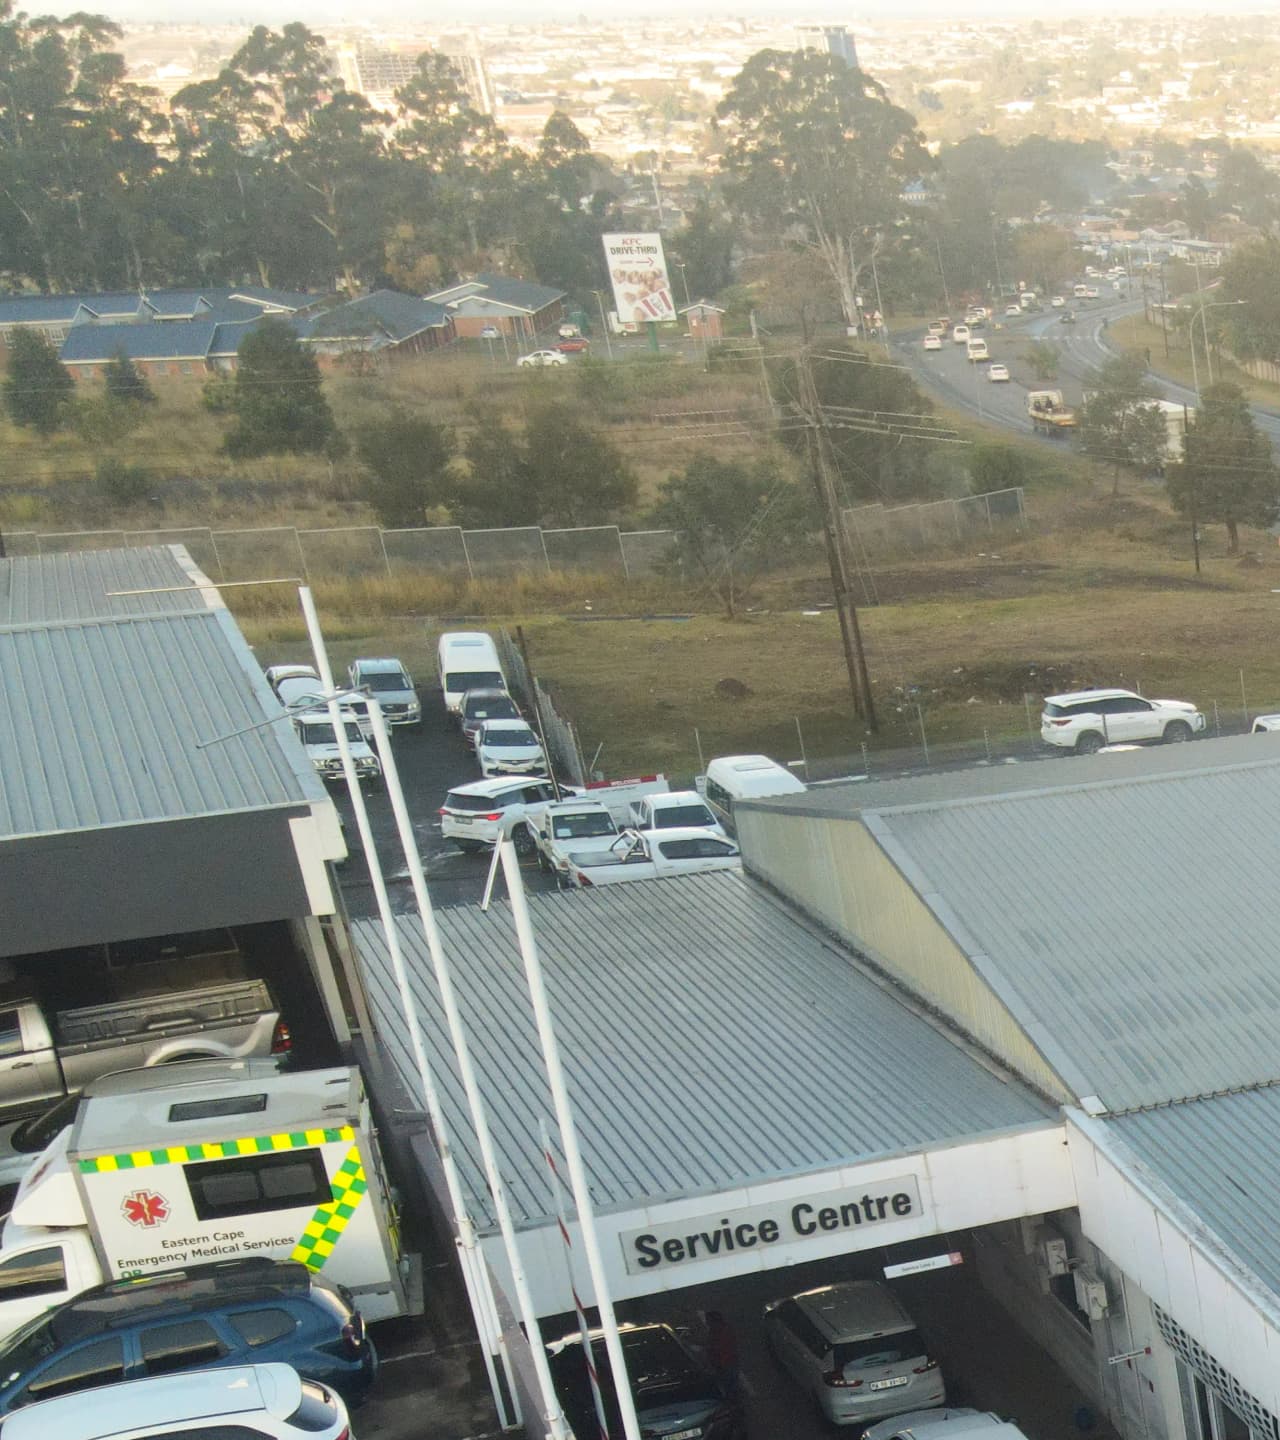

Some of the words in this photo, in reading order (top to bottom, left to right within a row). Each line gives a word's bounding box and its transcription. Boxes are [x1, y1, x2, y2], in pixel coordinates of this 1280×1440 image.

[610, 246, 657, 255] DRIVE-THRU
[621, 238, 642, 246] KFC
[161, 1234, 210, 1249] Eastern
[213, 1229, 245, 1242] Cape
[634, 1218, 780, 1268] Service
[792, 1191, 912, 1238] Centre
[117, 1252, 188, 1269] Emergency
[191, 1243, 240, 1258] Medical
[243, 1236, 295, 1251] Services
